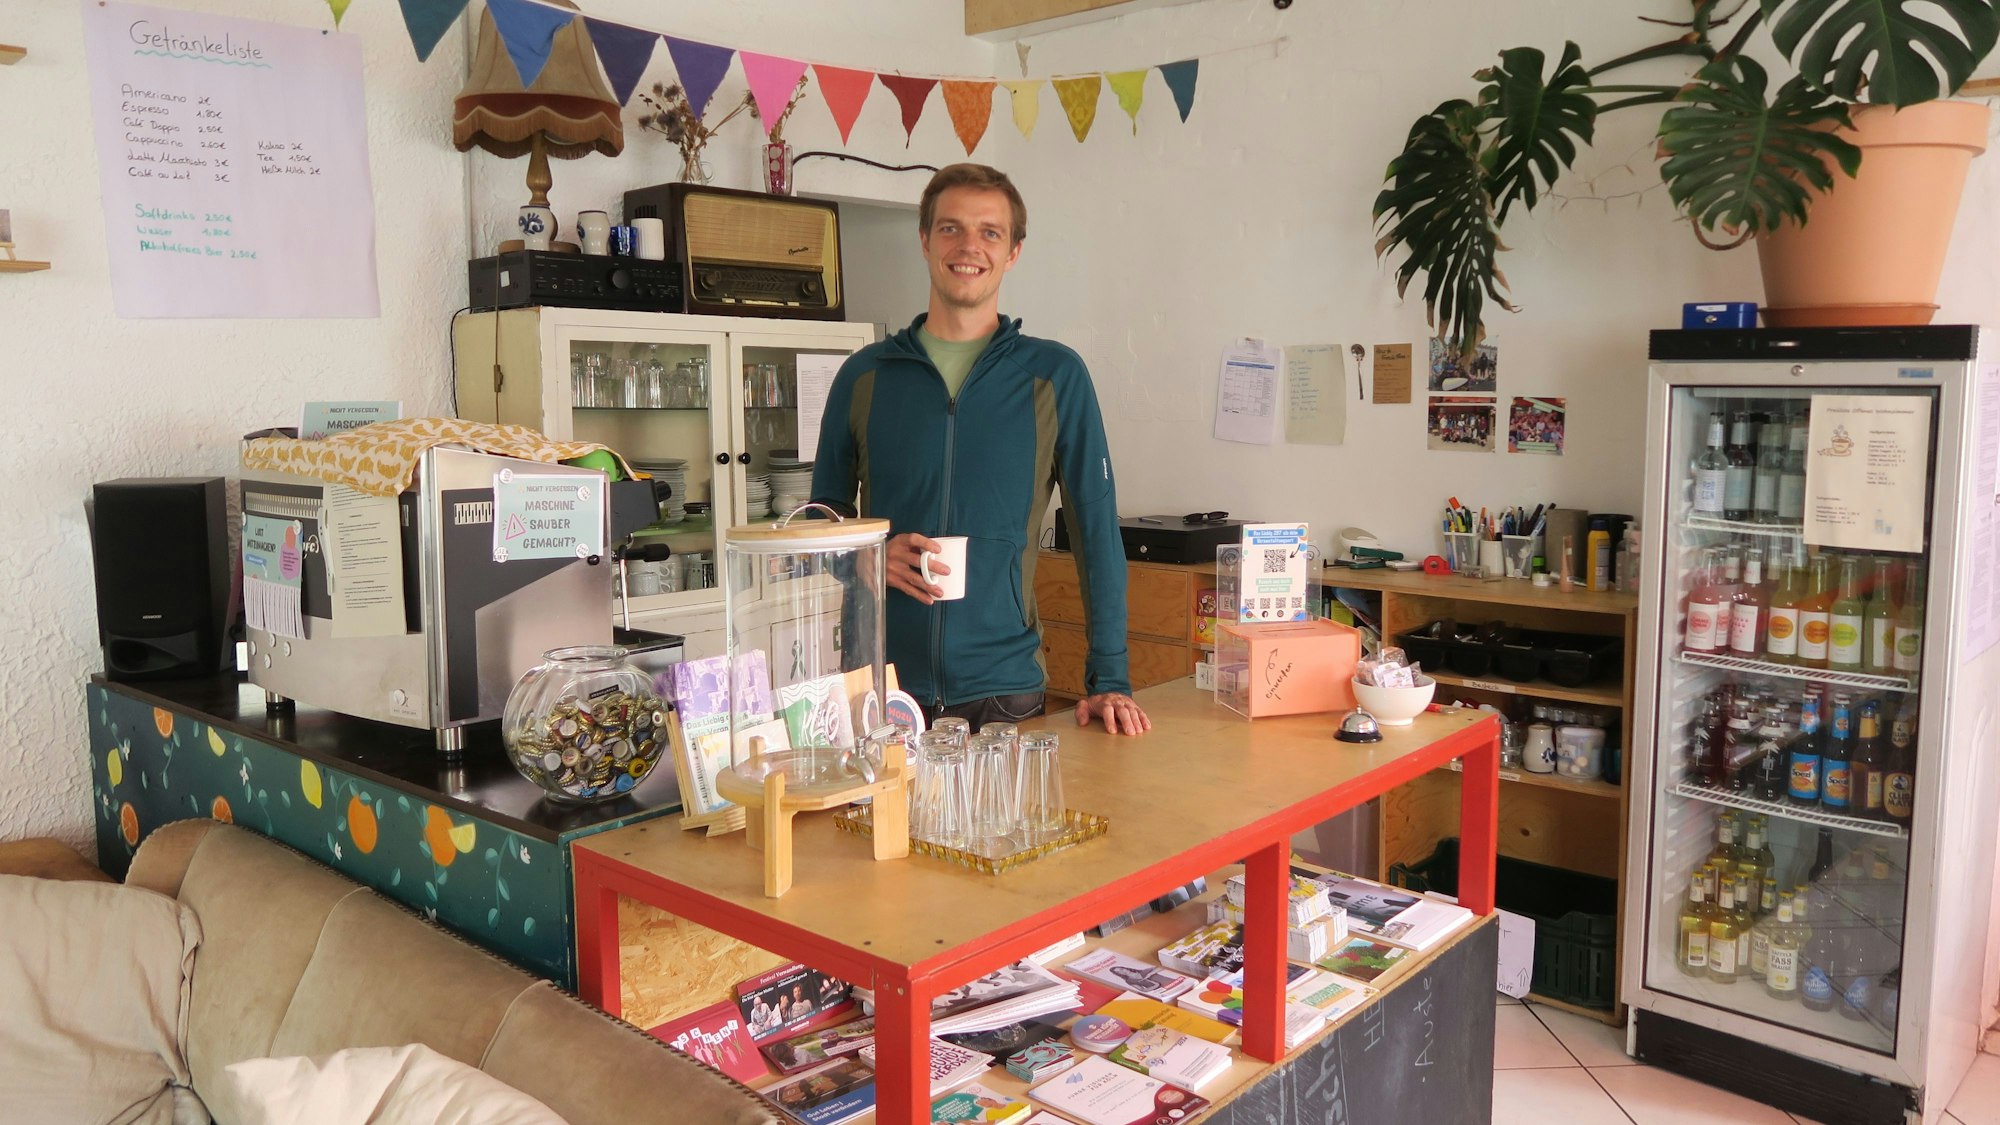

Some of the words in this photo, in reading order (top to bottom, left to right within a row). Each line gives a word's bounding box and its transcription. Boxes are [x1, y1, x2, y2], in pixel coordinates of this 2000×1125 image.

[129, 19, 263, 60] Getränkeliste
[122, 101, 169, 115] Espresso
[257, 153, 274, 161] Tee
[525, 500, 575, 512] MASCHINE
[529, 519, 571, 530] SAUBER
[522, 537, 576, 549] GEMACHT?
